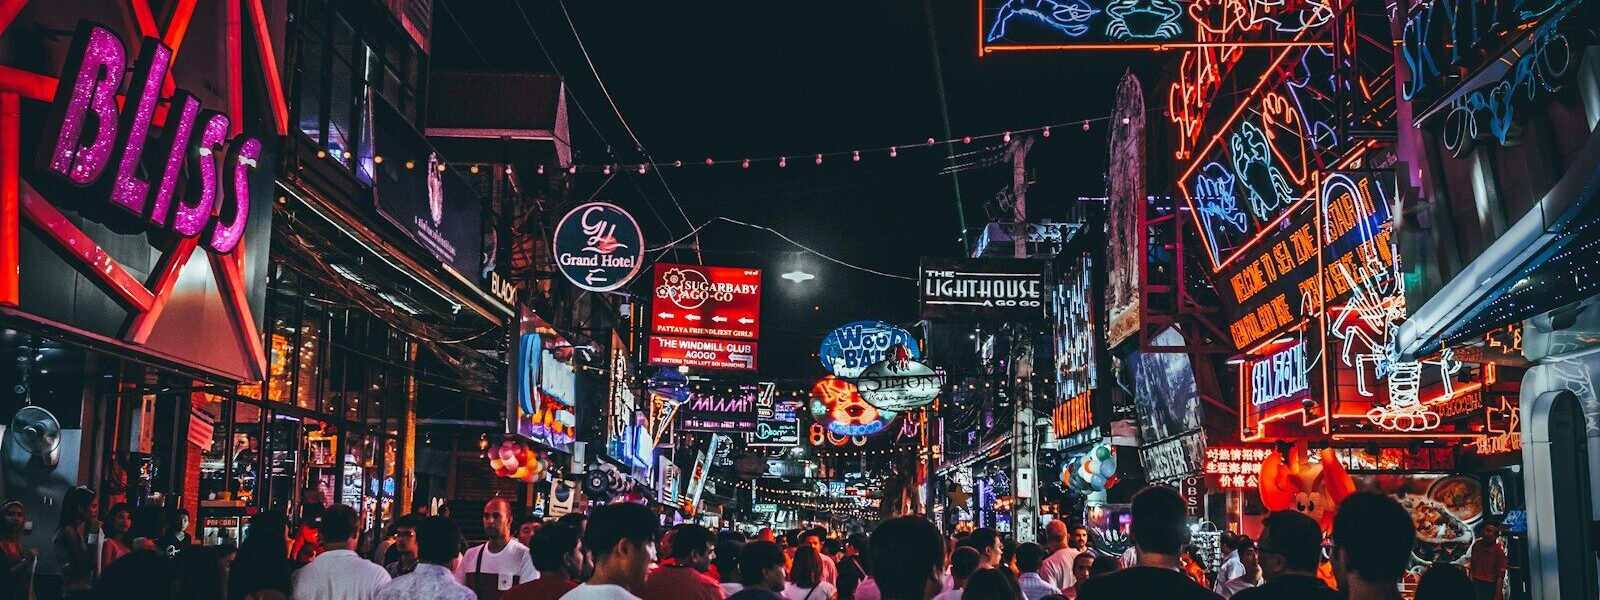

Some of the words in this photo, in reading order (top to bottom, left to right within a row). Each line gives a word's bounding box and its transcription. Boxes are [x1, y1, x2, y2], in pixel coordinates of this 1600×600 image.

[50, 24, 263, 255] BLISS
[1260, 252, 1277, 283] TO
[1273, 240, 1296, 275] SEA
[1289, 223, 1318, 266] ZONE
[560, 253, 598, 266] Grand
[601, 254, 635, 268] Hotel
[925, 270, 955, 278] THE
[684, 281, 758, 295] SUGARBABY
[925, 278, 1040, 298] LIGHTHOUSE
[681, 290, 734, 302] AGO-GO
[657, 325, 688, 333] PATTAYA
[689, 326, 732, 336] FRIENDLIEST
[658, 339, 678, 348] THE
[679, 340, 725, 352] WINDMILL
[726, 343, 751, 353] CLUB
[685, 350, 716, 360] AGOGO
[865, 371, 936, 391] SIMON
[691, 395, 748, 412] MIAMI
